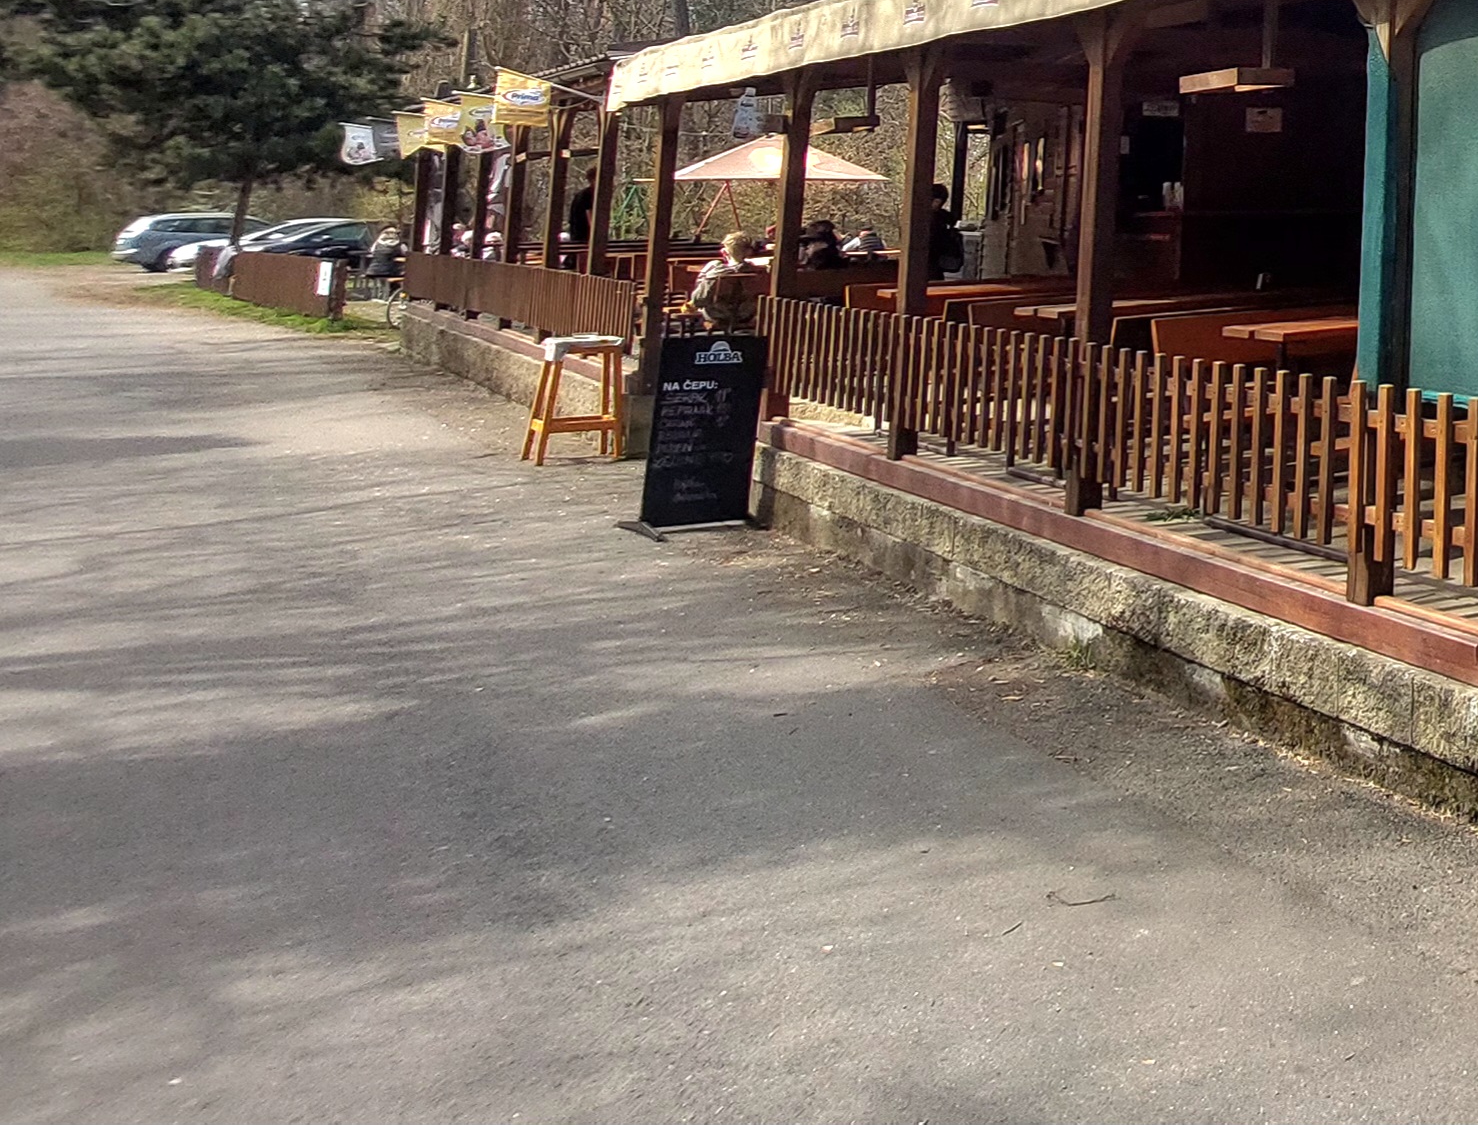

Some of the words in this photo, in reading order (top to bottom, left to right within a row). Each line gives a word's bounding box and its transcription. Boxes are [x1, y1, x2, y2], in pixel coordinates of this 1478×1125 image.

[695, 351, 743, 365] HOLBA
[663, 381, 680, 392] NA
[683, 378, 719, 391] ČEPU:
